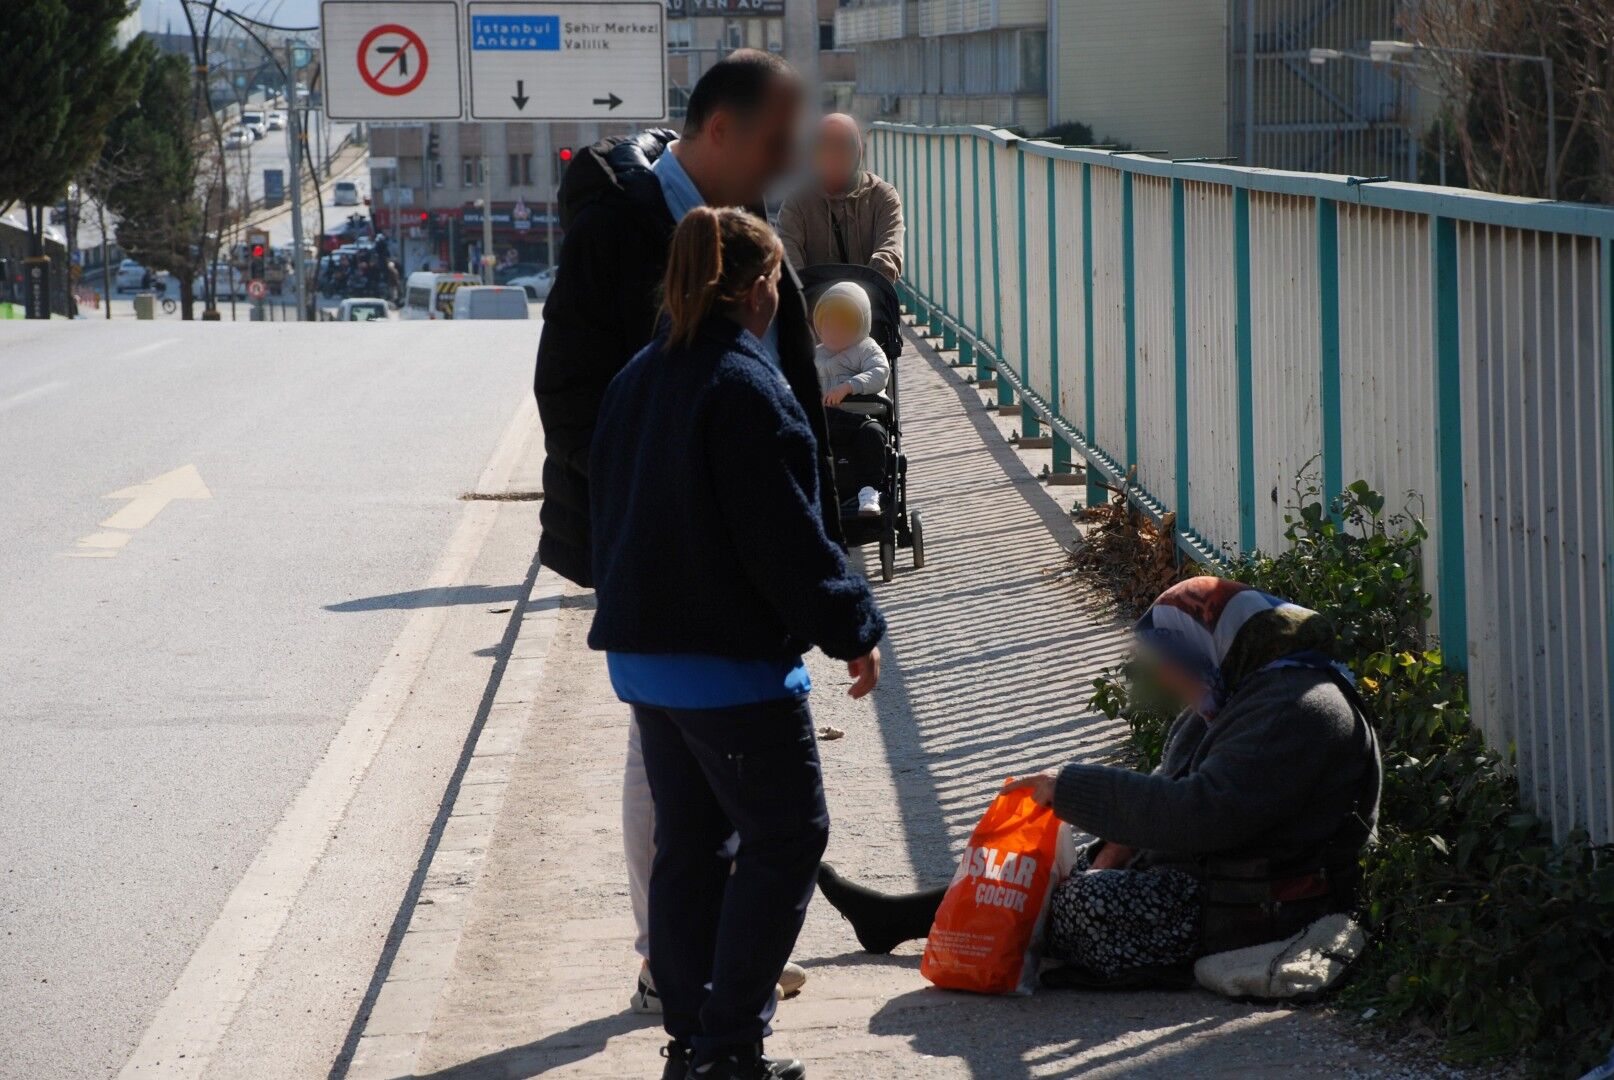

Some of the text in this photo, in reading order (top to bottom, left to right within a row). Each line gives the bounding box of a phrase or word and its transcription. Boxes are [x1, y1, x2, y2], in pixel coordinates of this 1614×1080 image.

[475, 19, 550, 34] İstanbul
[564, 22, 659, 35] Şehir Merkezi
[476, 35, 537, 47] Ankara
[564, 39, 611, 50] Valilik
[975, 883, 1029, 913] ÇOCUK
